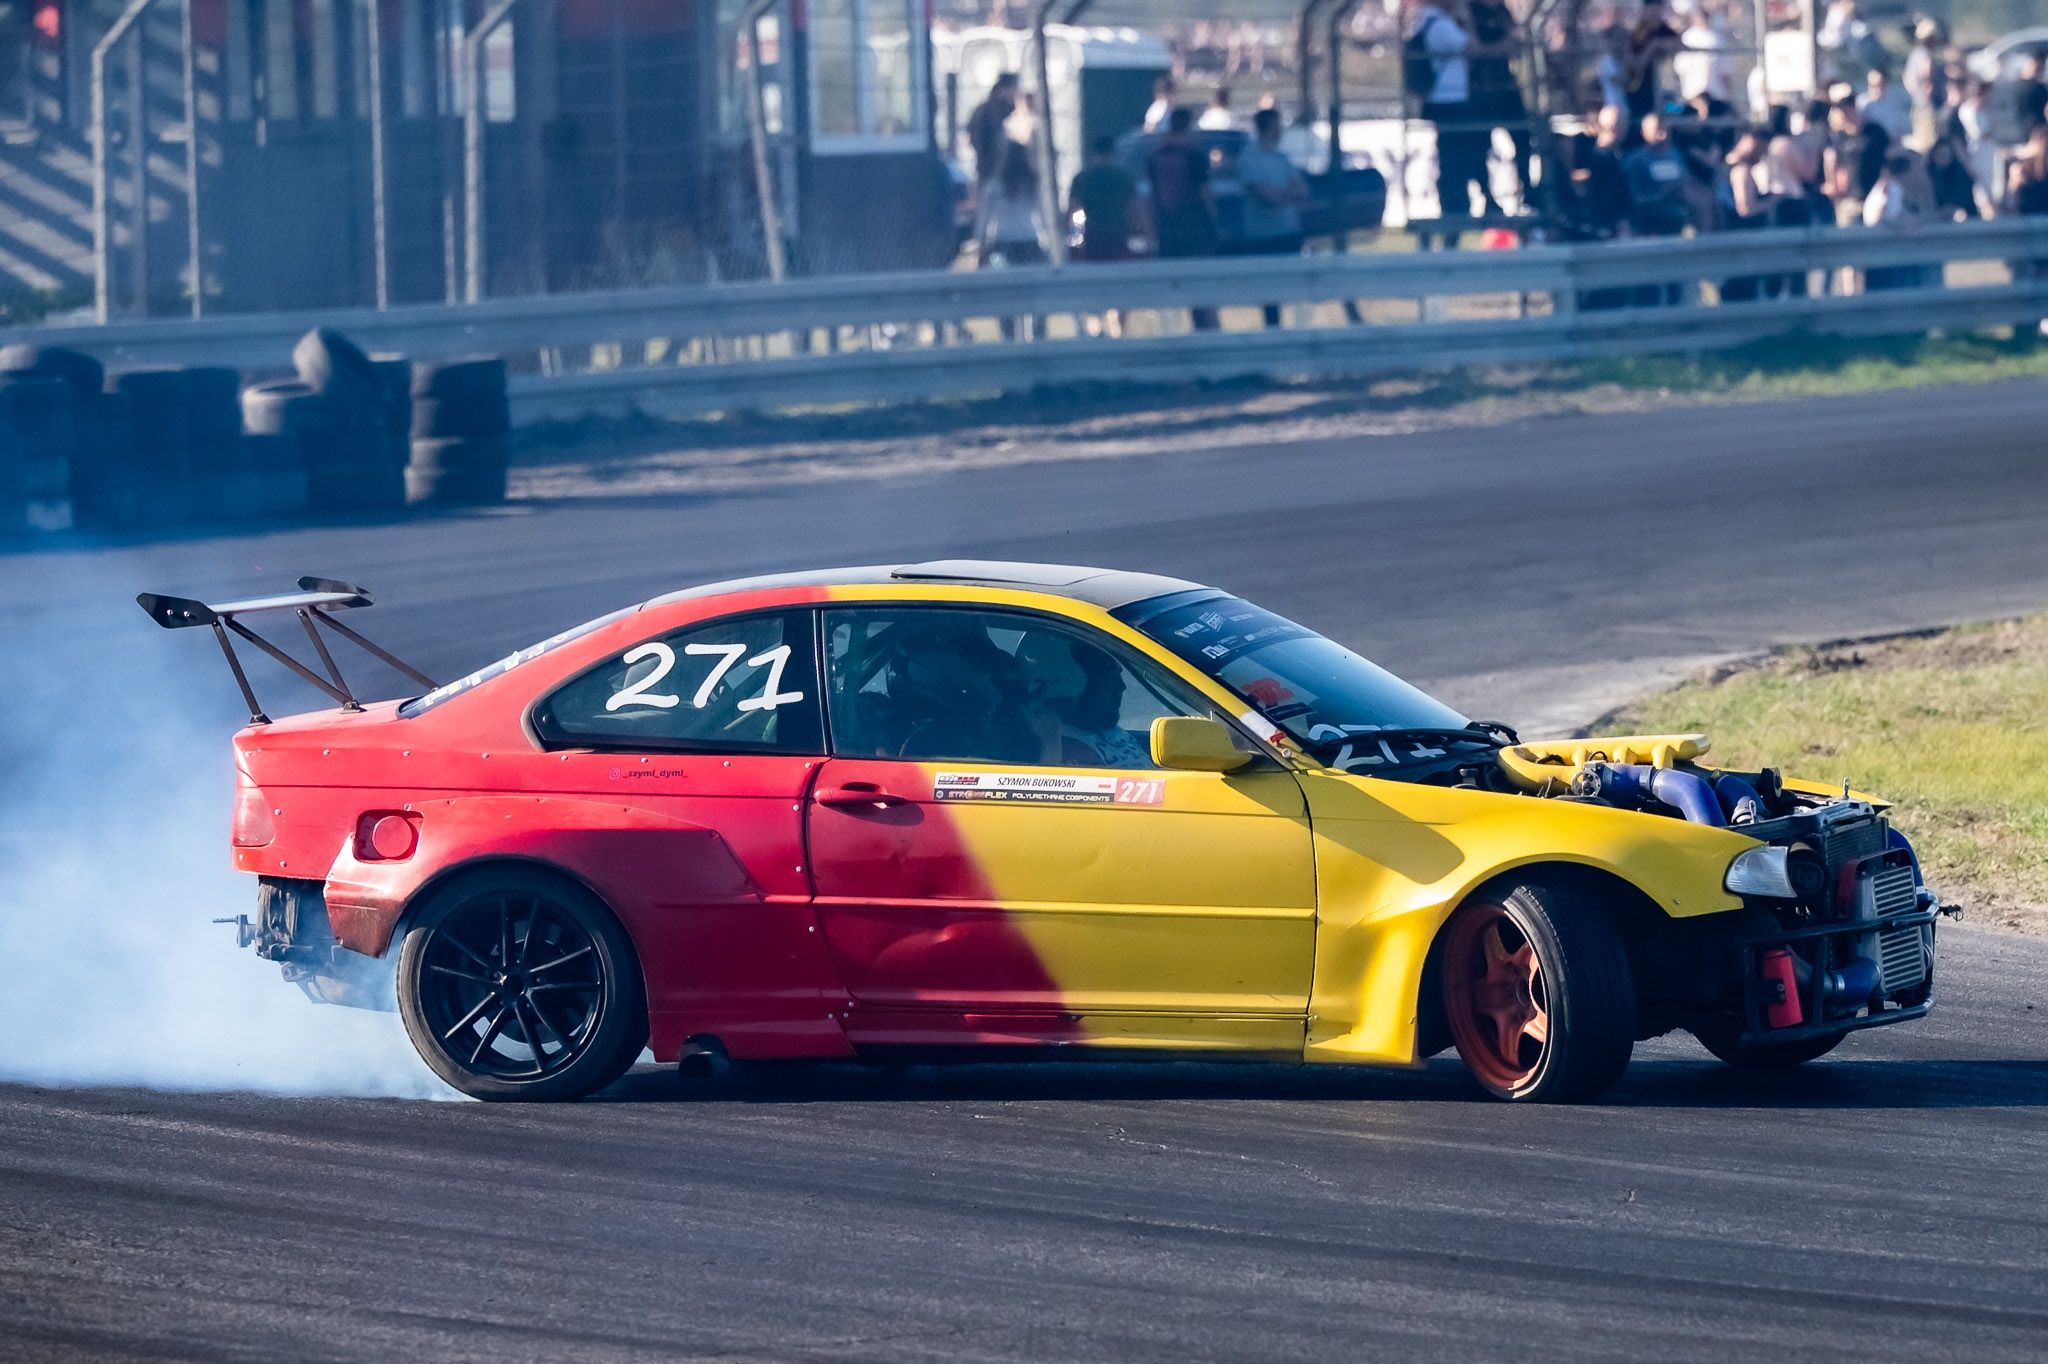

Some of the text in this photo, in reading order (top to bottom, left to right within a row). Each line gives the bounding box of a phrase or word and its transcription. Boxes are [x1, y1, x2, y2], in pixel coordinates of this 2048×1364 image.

[605, 642, 804, 712] 271
[997, 777, 1076, 788] SZYMON BUKOWSKI
[1011, 793, 1065, 801] POLYURETHANE
[1117, 781, 1158, 804] 271
